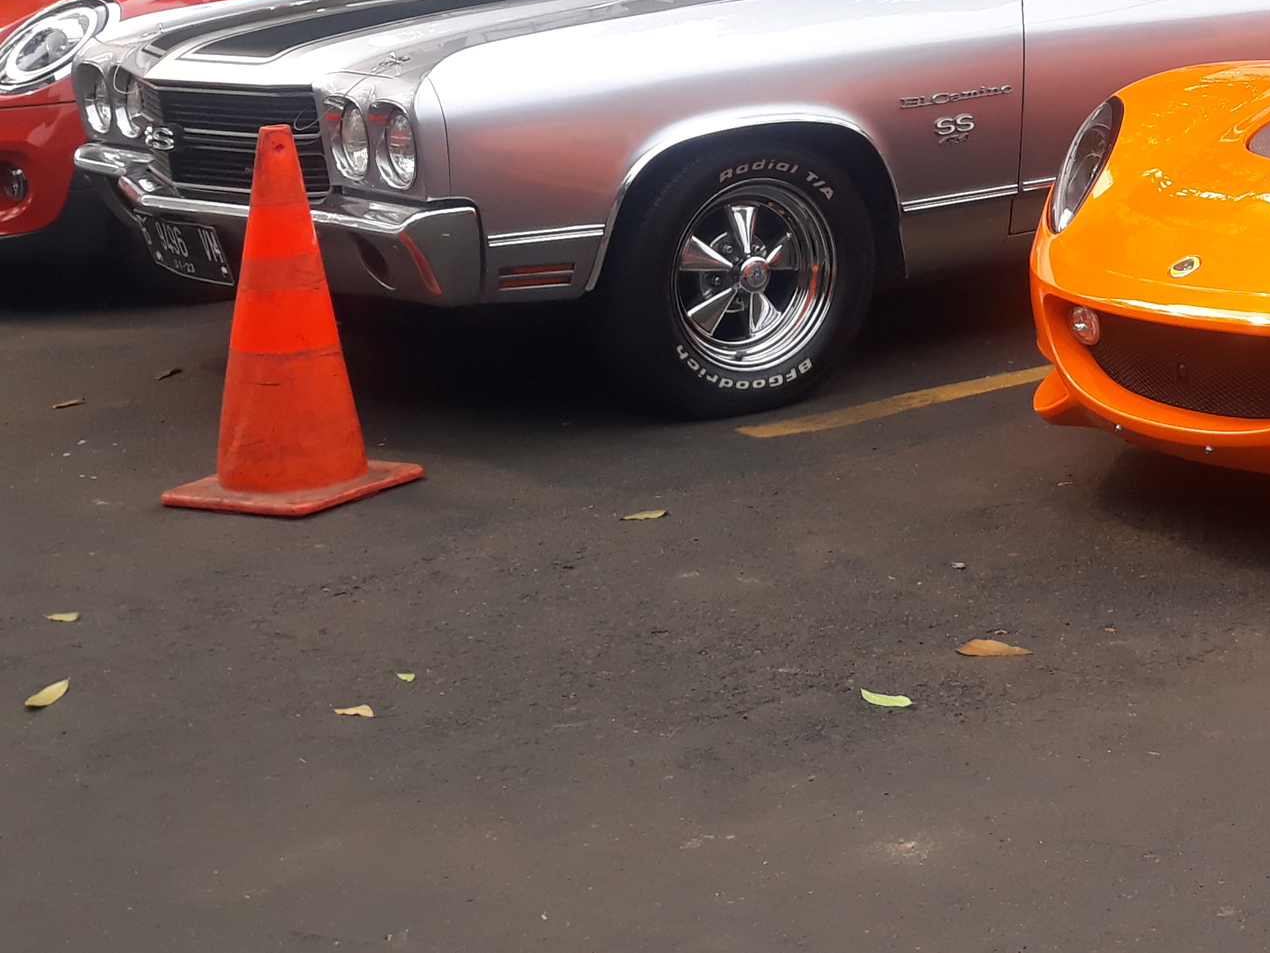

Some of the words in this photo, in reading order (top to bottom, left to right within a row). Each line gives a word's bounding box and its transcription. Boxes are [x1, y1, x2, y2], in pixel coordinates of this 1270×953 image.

[935, 113, 975, 136] SS
[719, 159, 799, 183] Radial
[805, 170, 835, 201] T/A
[155, 220, 189, 258] 9496
[676, 344, 813, 390] BFGoodrich
